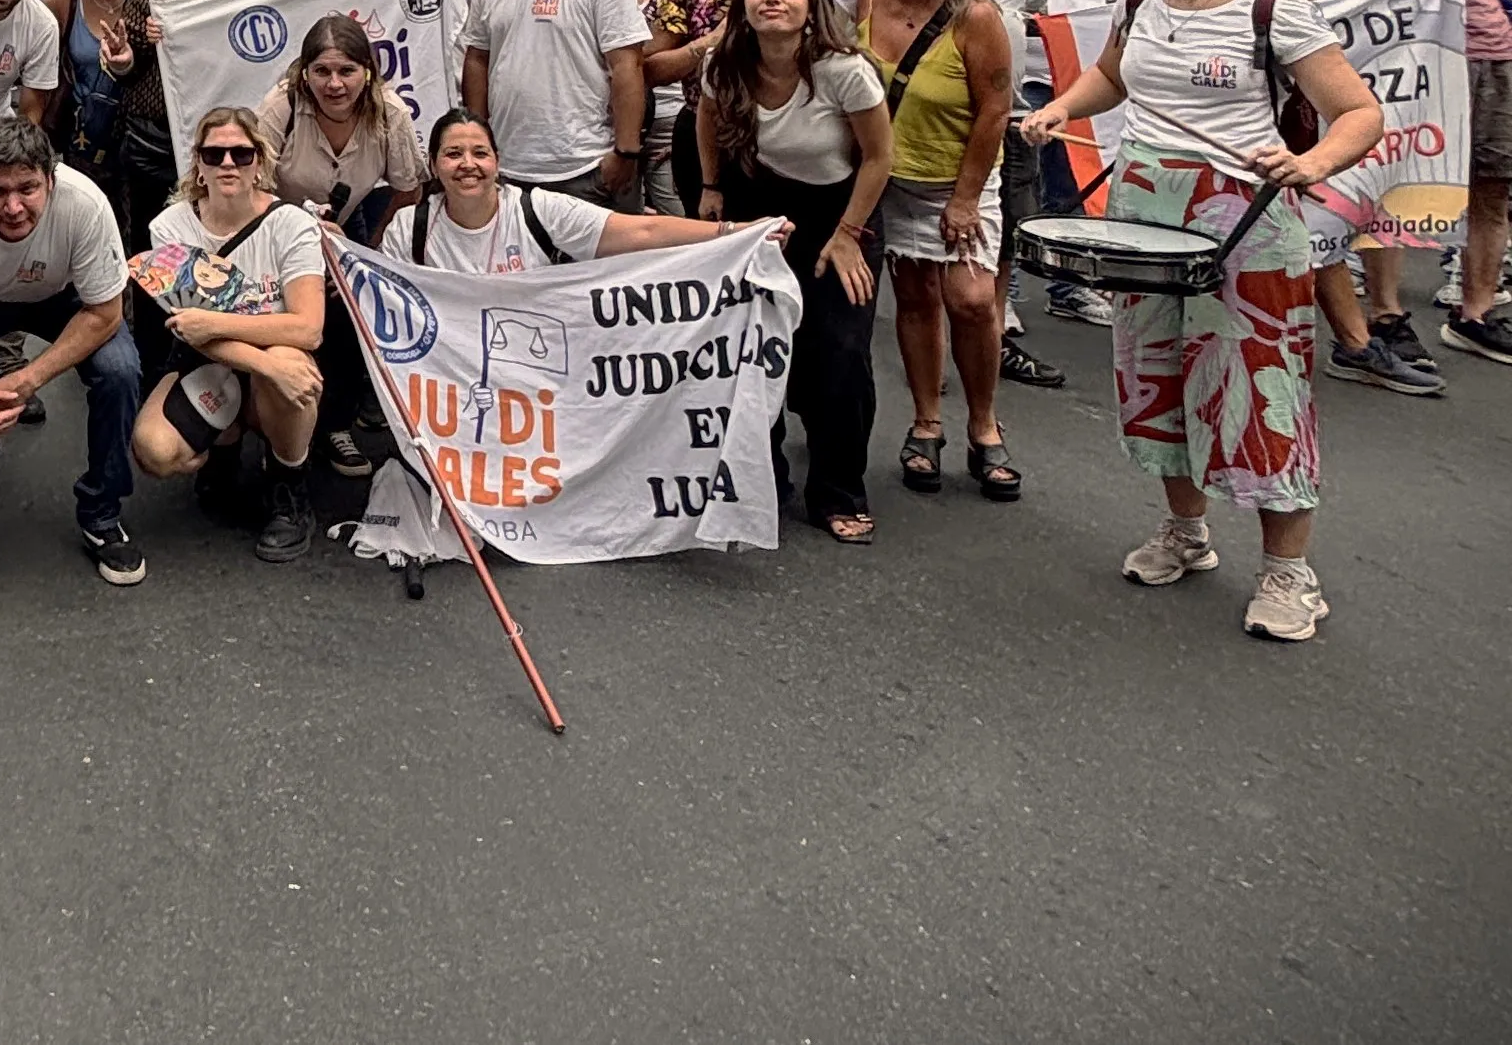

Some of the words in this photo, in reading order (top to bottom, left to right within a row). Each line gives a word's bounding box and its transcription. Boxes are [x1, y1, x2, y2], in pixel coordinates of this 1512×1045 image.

[238, 14, 276, 53] CGT
[1363, 6, 1416, 46] DE
[1359, 65, 1430, 105] RZA
[437, 445, 564, 508] ALES
